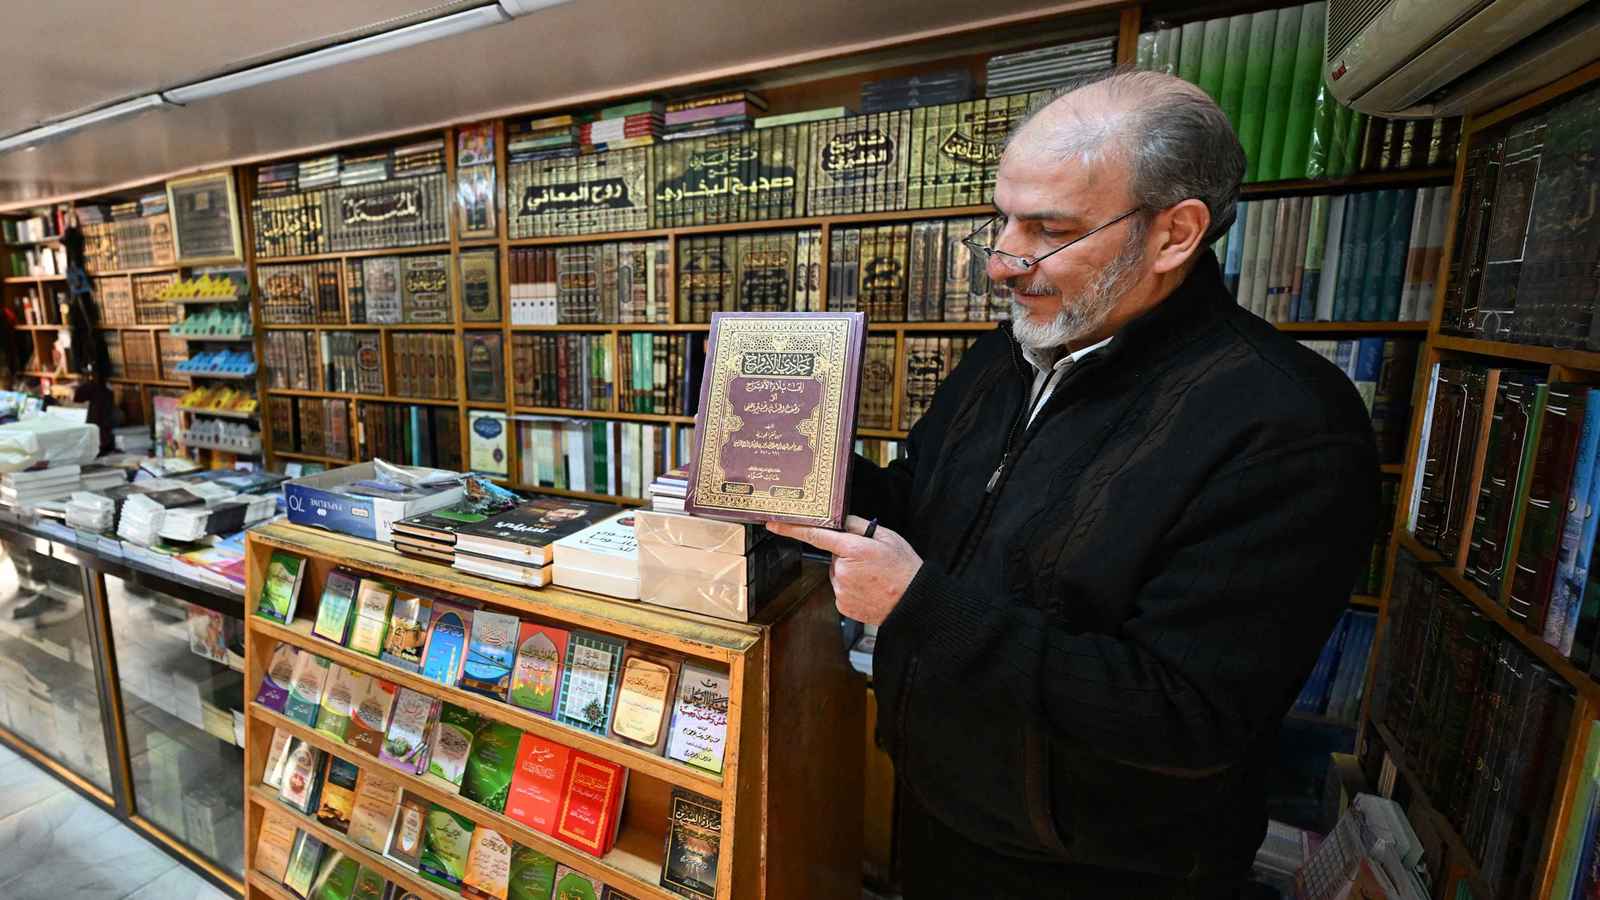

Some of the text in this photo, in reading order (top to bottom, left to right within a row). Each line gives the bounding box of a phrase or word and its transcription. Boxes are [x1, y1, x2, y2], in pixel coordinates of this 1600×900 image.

[831, 134, 886, 154] تاريخ
[828, 150, 886, 170] الطبري
[526, 184, 622, 210] روح المعاني
[656, 176, 794, 201] صحيح البخاري
[777, 353, 813, 375] حادي
[288, 495, 305, 512] 70
[701, 679, 718, 688] من
[701, 814, 721, 830] صلاة
